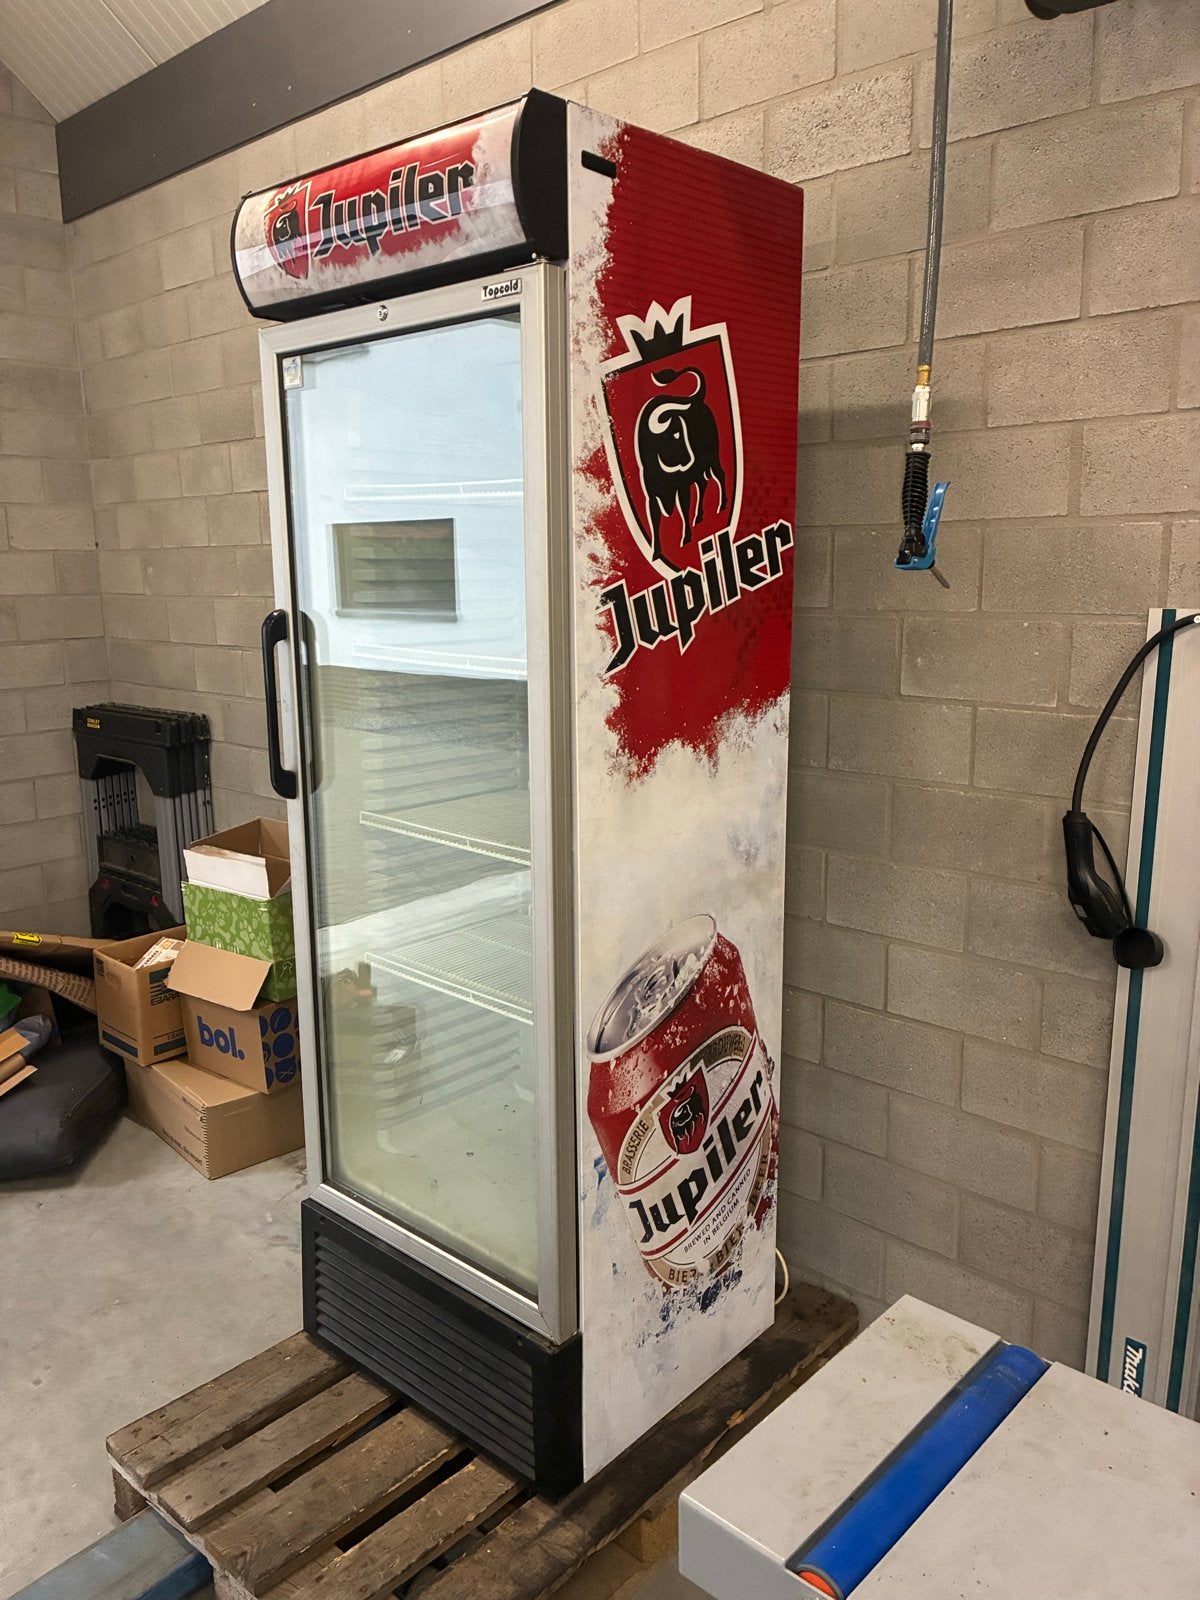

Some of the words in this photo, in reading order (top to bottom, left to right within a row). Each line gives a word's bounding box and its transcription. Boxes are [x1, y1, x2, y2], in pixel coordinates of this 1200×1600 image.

[308, 160, 475, 260] Jupiler
[482, 279, 519, 299] Topcold
[597, 519, 794, 676] Jupiler
[197, 1015, 244, 1060] bol.
[622, 1120, 649, 1175] BRASSERIE
[628, 1070, 763, 1243] Jupiler
[683, 1225, 711, 1253] BREWED
[710, 1205, 726, 1225] AND
[727, 1168, 751, 1204] CANNED
[703, 1234, 711, 1245] IN
[711, 1198, 739, 1235] BELGIUM
